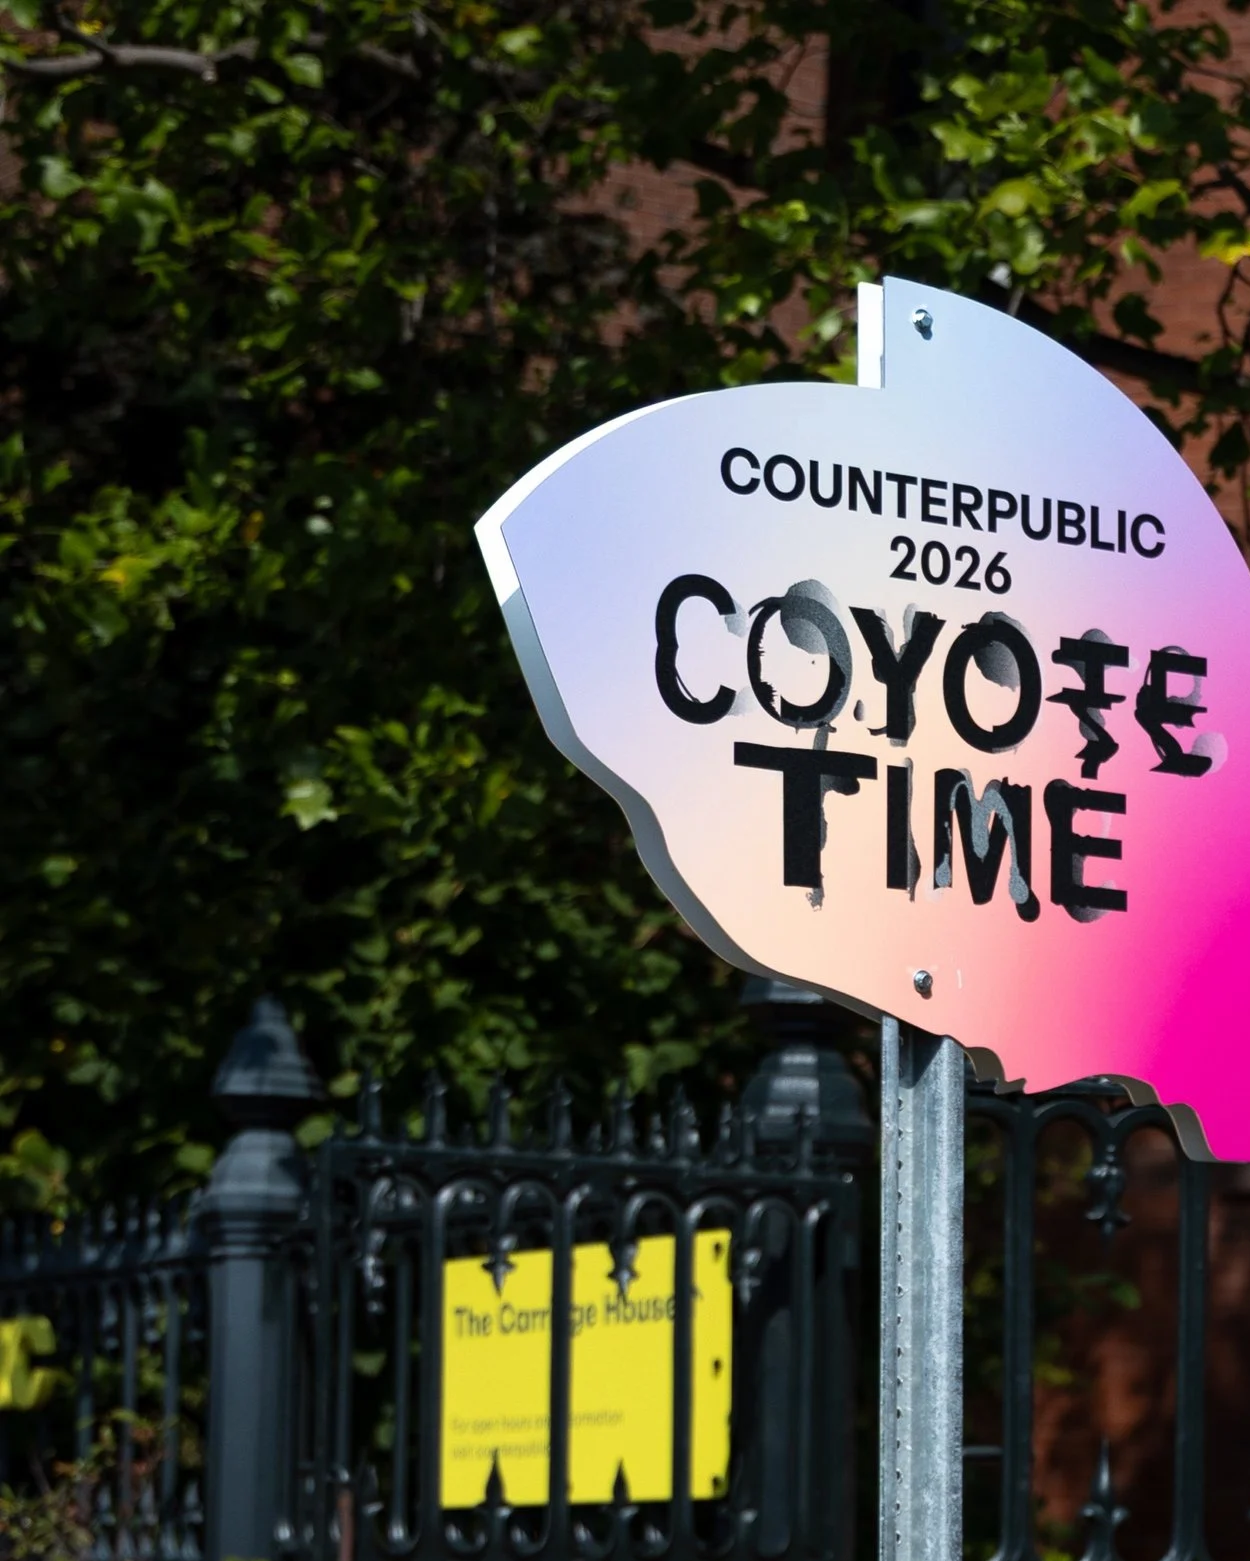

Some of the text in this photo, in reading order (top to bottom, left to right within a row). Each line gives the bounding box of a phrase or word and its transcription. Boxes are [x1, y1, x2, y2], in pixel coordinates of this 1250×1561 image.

[720, 447, 1167, 559] COUNTERPUBLIC
[890, 534, 1012, 594] 2026
[655, 574, 1214, 779] COYOTE
[733, 742, 1128, 922] TIME
[454, 1293, 676, 1339] The Carrge House
